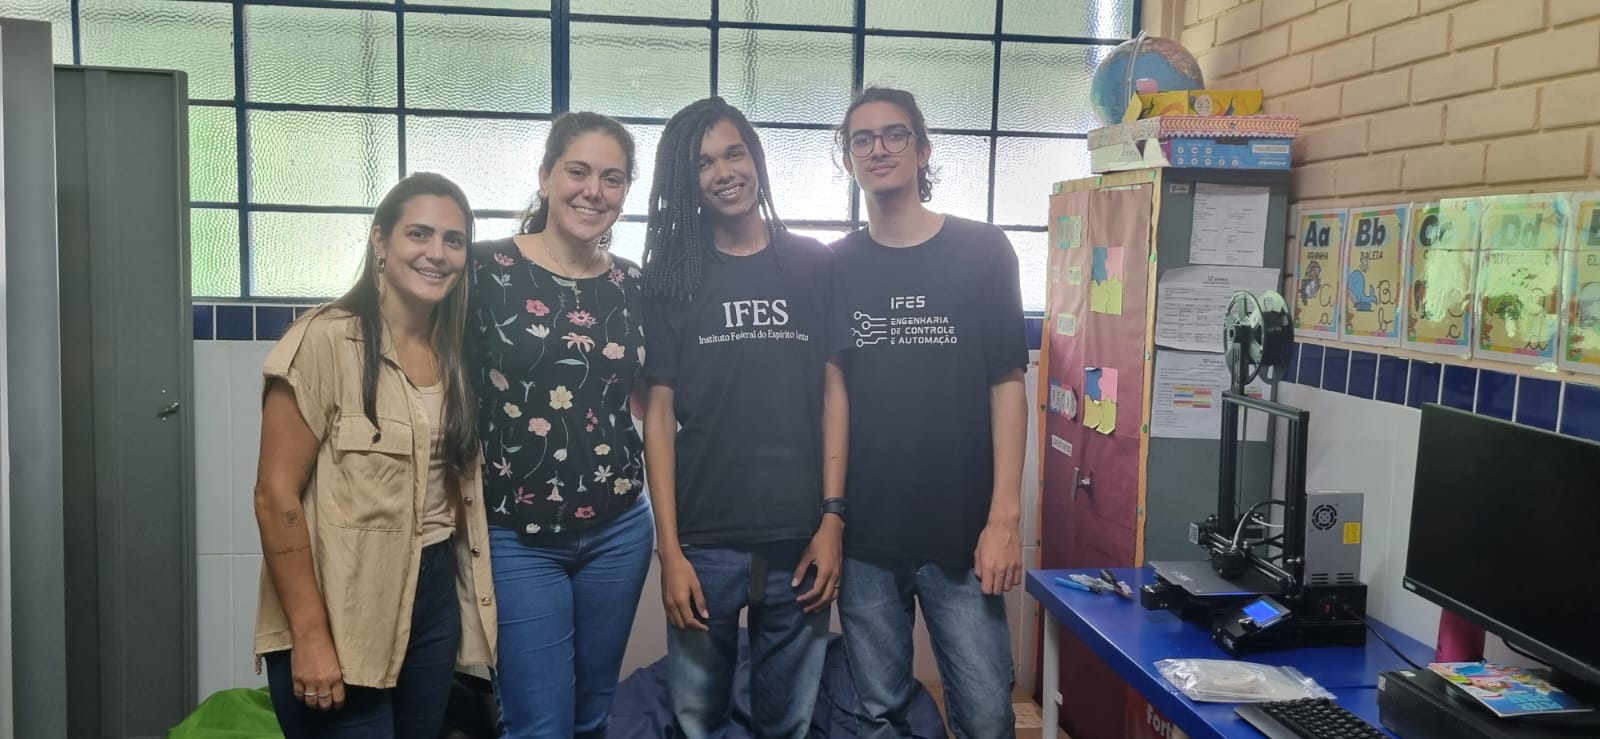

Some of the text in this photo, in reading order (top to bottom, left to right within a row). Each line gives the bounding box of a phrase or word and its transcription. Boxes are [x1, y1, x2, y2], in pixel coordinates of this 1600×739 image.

[1304, 221, 1330, 247] Aa
[1355, 217, 1386, 246] Bb
[1499, 213, 1543, 248] Dd
[891, 296, 925, 309] IFES
[722, 299, 789, 328] IFES
[891, 316, 949, 326] ENGENHARIA
[699, 334, 731, 345] Instituto
[757, 329, 767, 339] do
[891, 326, 955, 335] DE CONTROLE
[891, 335, 957, 346] E AUTOMAÇÃO
